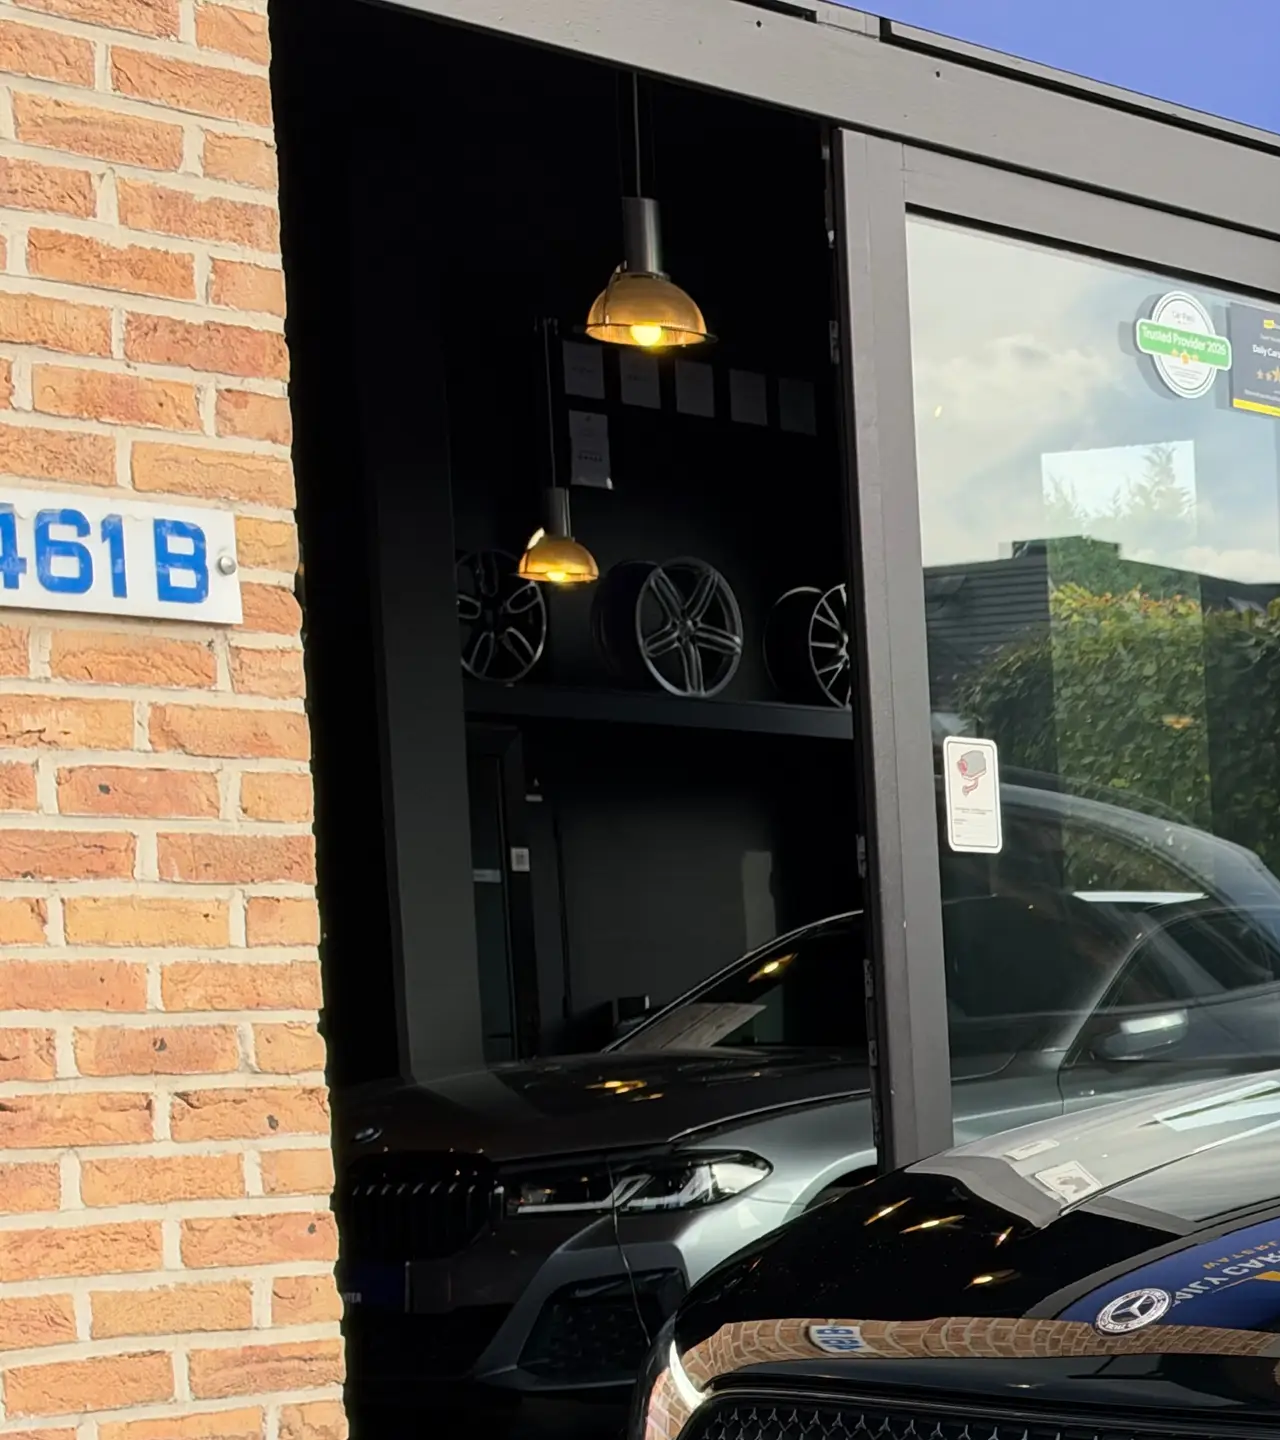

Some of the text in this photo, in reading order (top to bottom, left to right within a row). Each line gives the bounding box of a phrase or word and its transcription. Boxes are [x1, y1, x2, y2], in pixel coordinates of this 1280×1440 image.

[1141, 325, 1172, 344] Trusted
[1172, 330, 1207, 352] Provider
[153, 517, 210, 605] B
